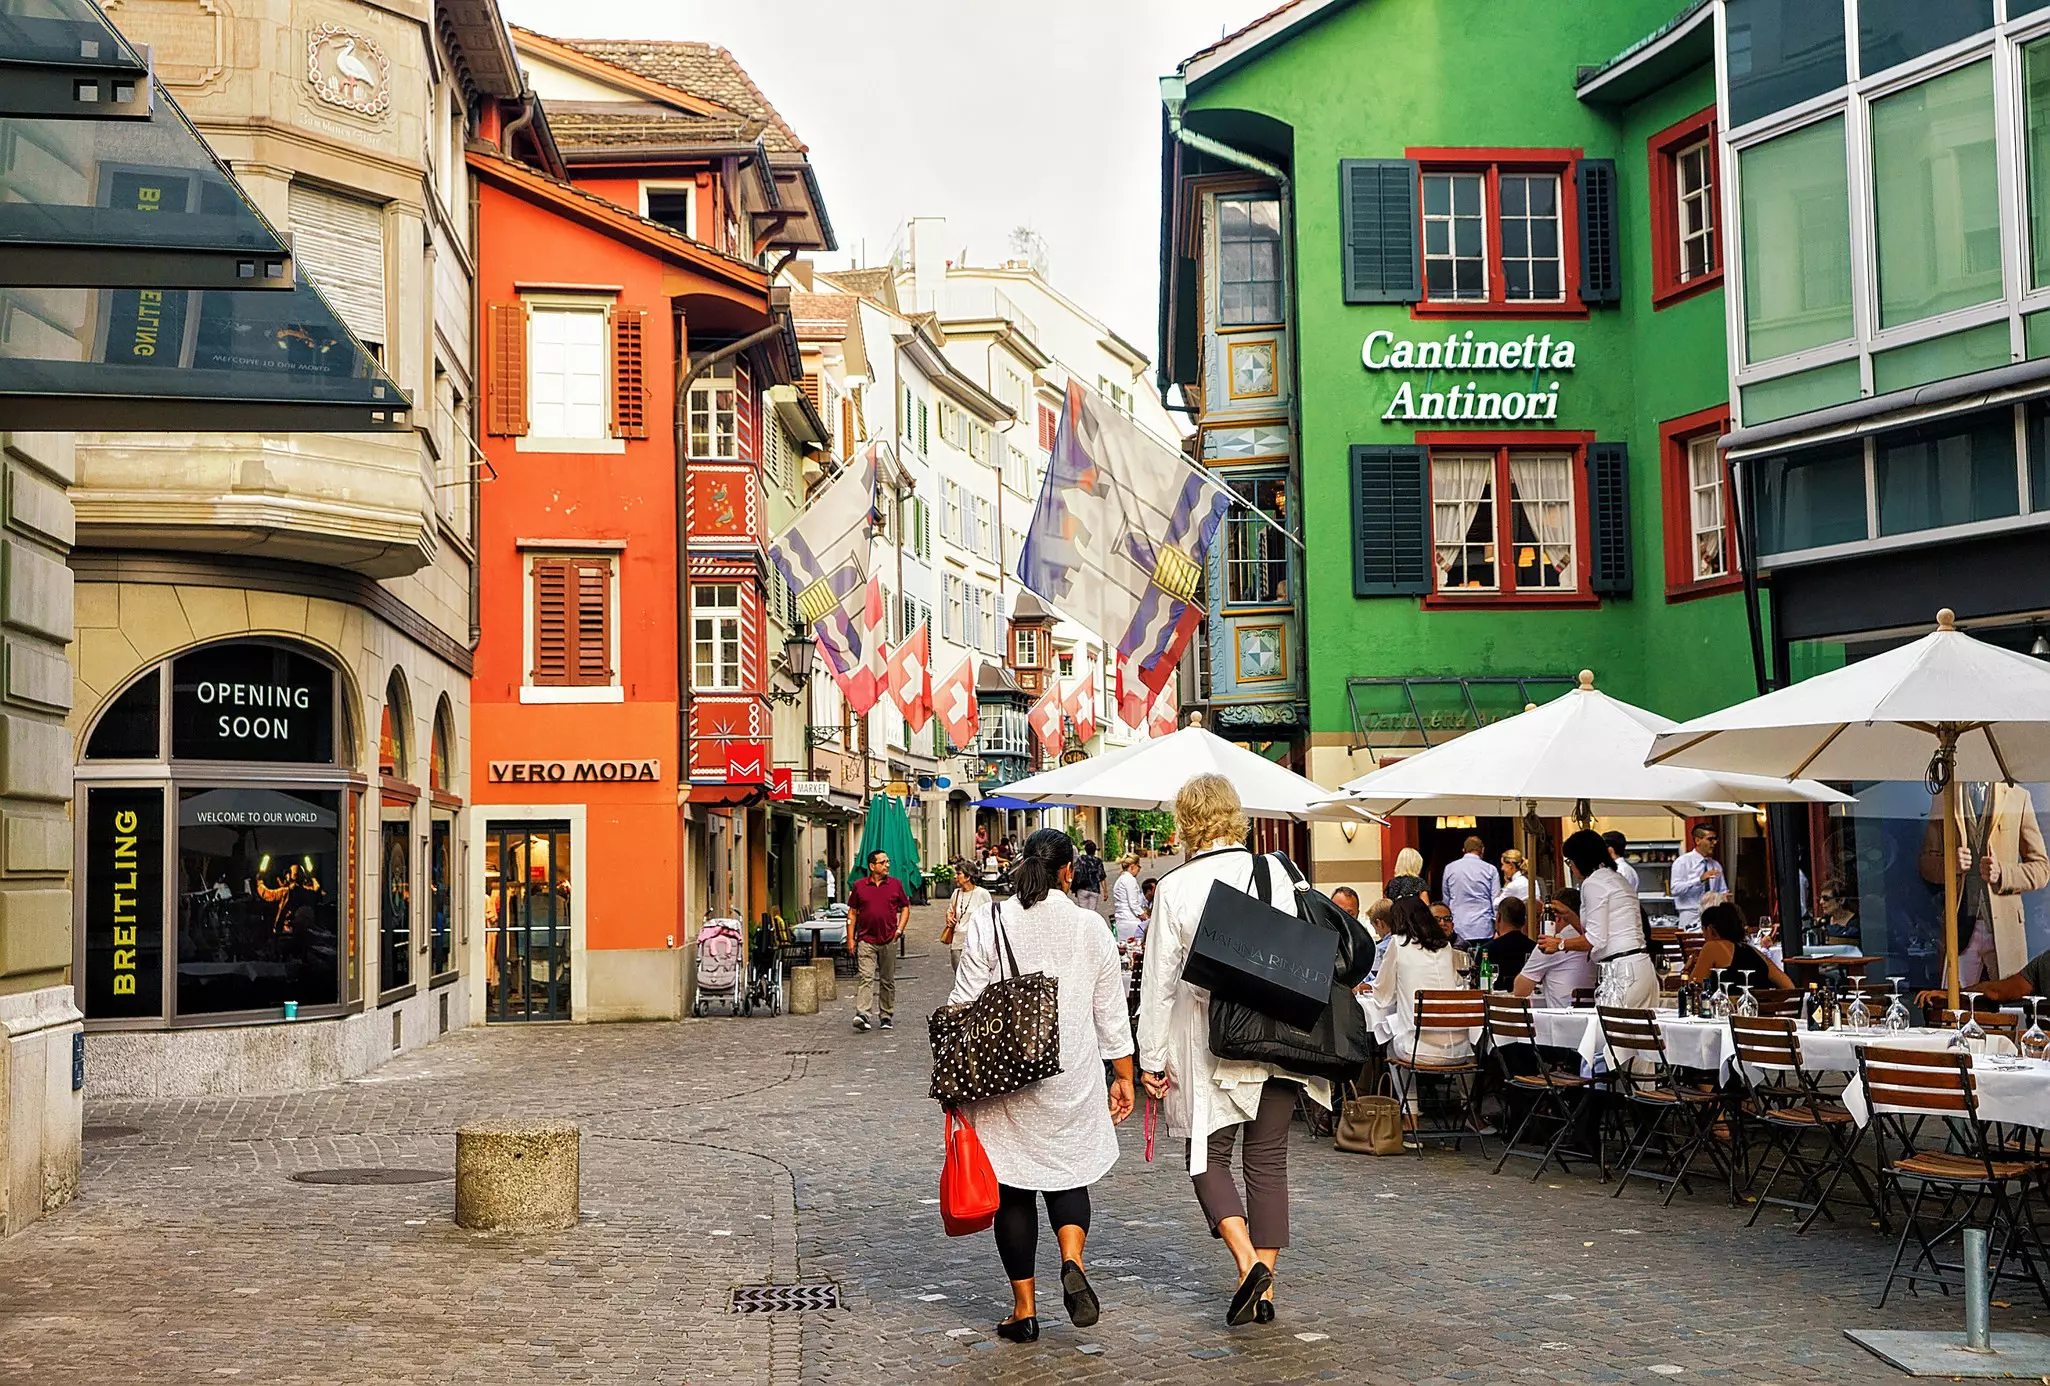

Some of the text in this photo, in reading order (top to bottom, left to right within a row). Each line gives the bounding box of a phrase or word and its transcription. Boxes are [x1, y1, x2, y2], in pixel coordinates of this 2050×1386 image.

[1361, 329, 1576, 369] Cantinetta
[1382, 381, 1560, 420] Antinori
[197, 681, 309, 709] OPENING
[218, 715, 288, 740] SOON
[492, 762, 654, 781] VERO MODA
[797, 783, 827, 794] MARKET
[197, 811, 318, 823] WELCOME TO OUR WORLD
[113, 810, 138, 996] BREITLING
